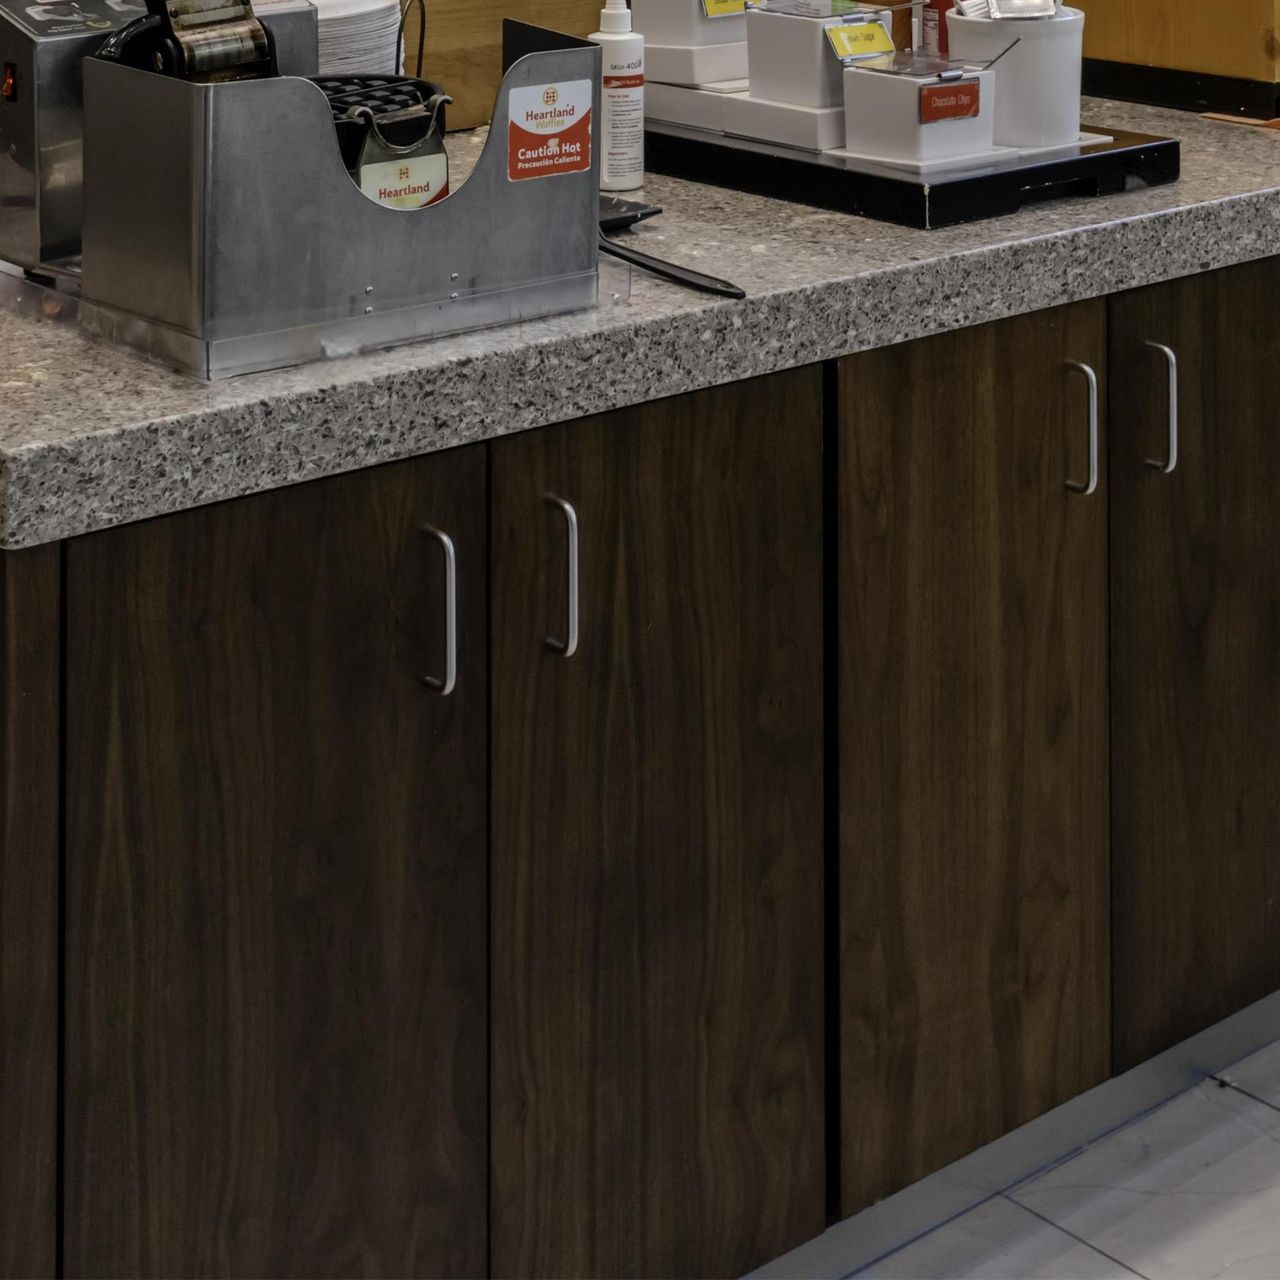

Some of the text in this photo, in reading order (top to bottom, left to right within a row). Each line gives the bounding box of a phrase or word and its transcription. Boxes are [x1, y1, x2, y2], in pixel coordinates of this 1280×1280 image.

[526, 105, 575, 121] Heartland
[535, 119, 565, 130] Waffles
[518, 142, 581, 160] Caution Hot
[517, 155, 581, 169] Precaución Caliente
[378, 181, 430, 200] Heartland
